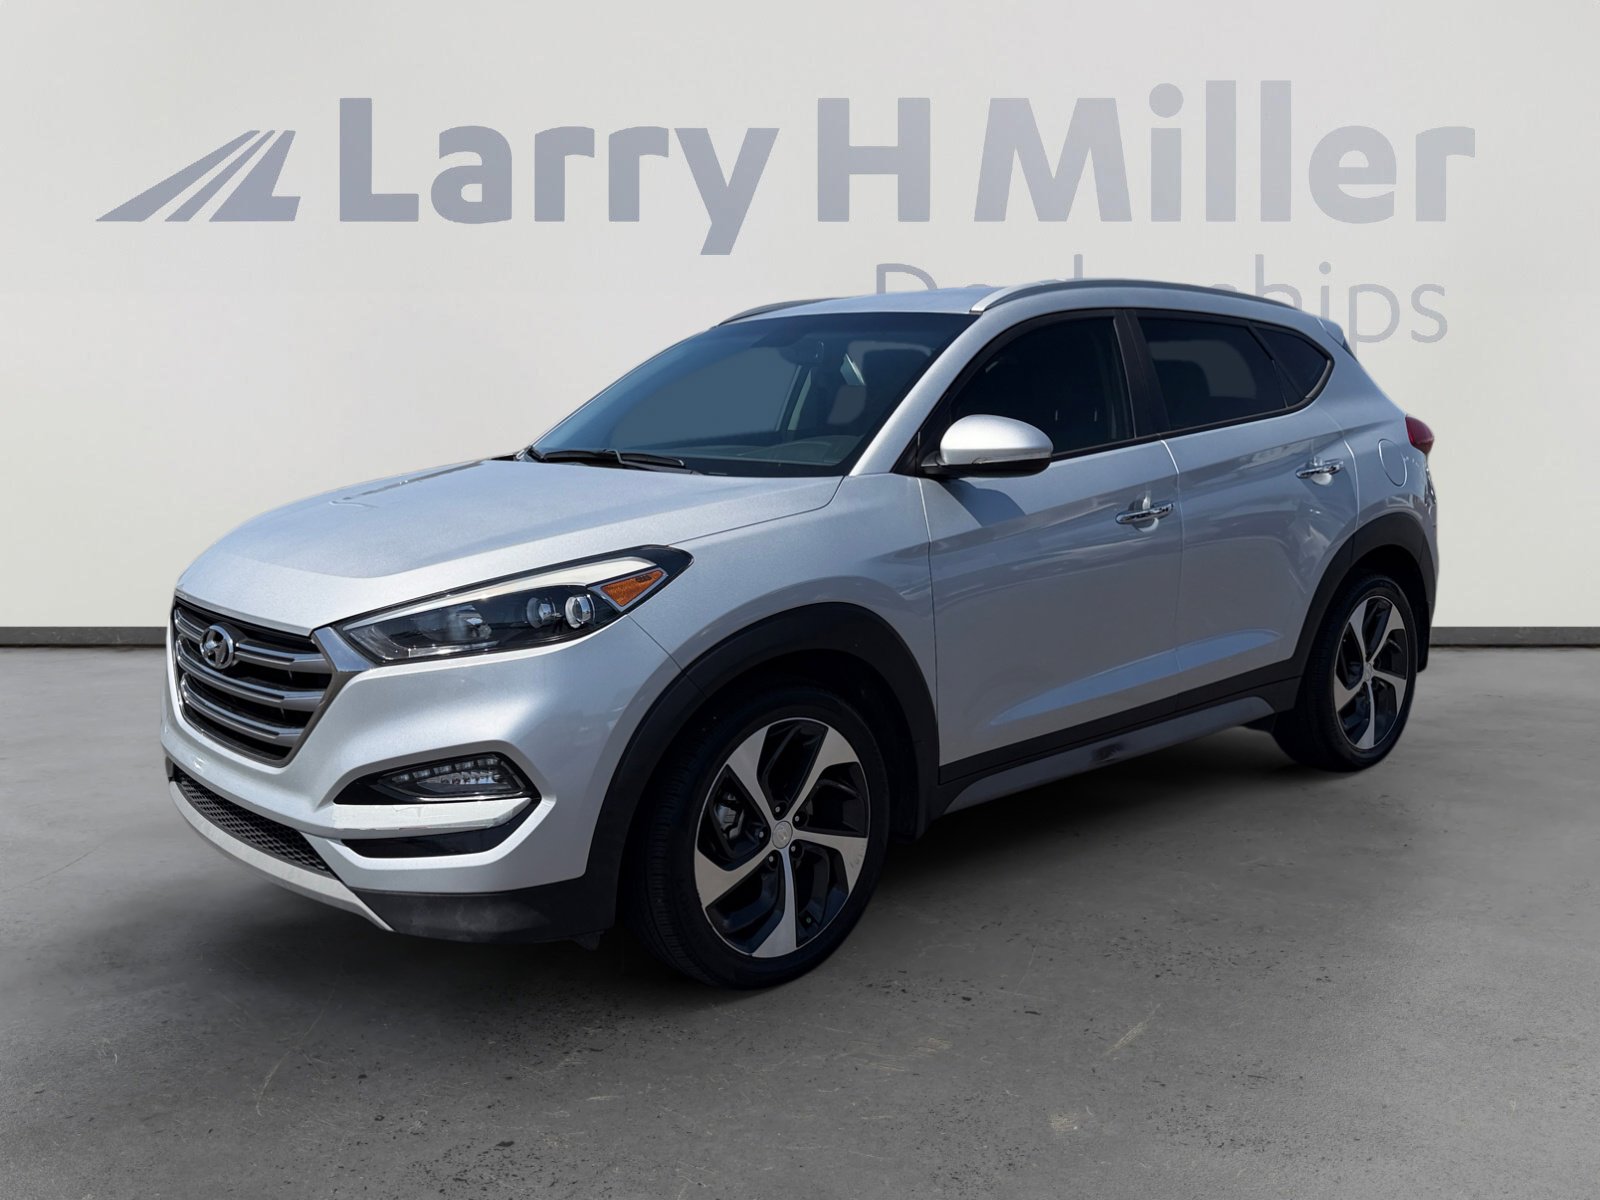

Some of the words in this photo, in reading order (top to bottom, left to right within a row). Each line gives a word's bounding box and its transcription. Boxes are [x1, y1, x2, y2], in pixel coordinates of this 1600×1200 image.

[339, 97, 780, 255] Larry
[817, 97, 931, 223] H
[974, 80, 1477, 224] Miller
